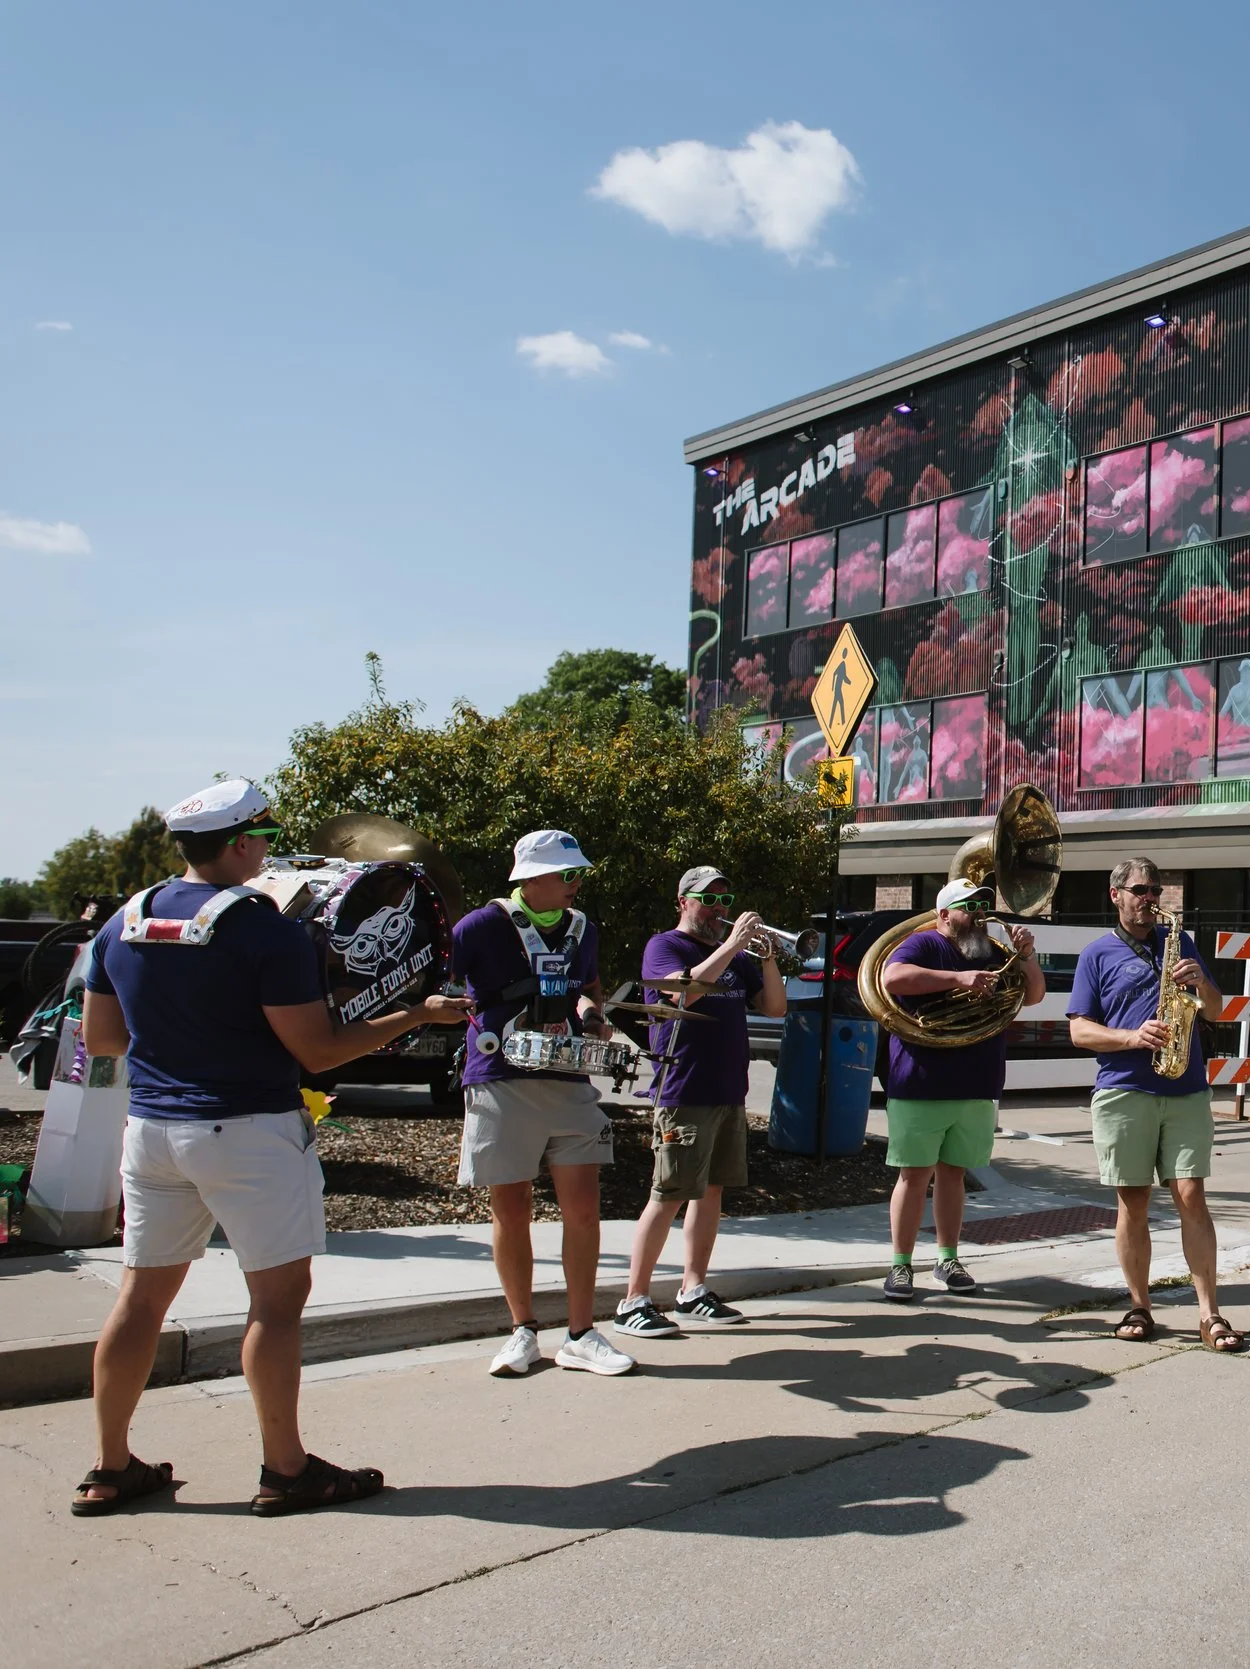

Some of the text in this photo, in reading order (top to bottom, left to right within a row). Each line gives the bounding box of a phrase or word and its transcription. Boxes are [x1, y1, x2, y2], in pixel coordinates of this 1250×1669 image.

[713, 478, 755, 526] THE
[741, 432, 857, 536] ARCADE
[340, 983, 381, 1025] MOBILE
[381, 962, 411, 996] FUNK
[410, 943, 434, 974] UNIT
